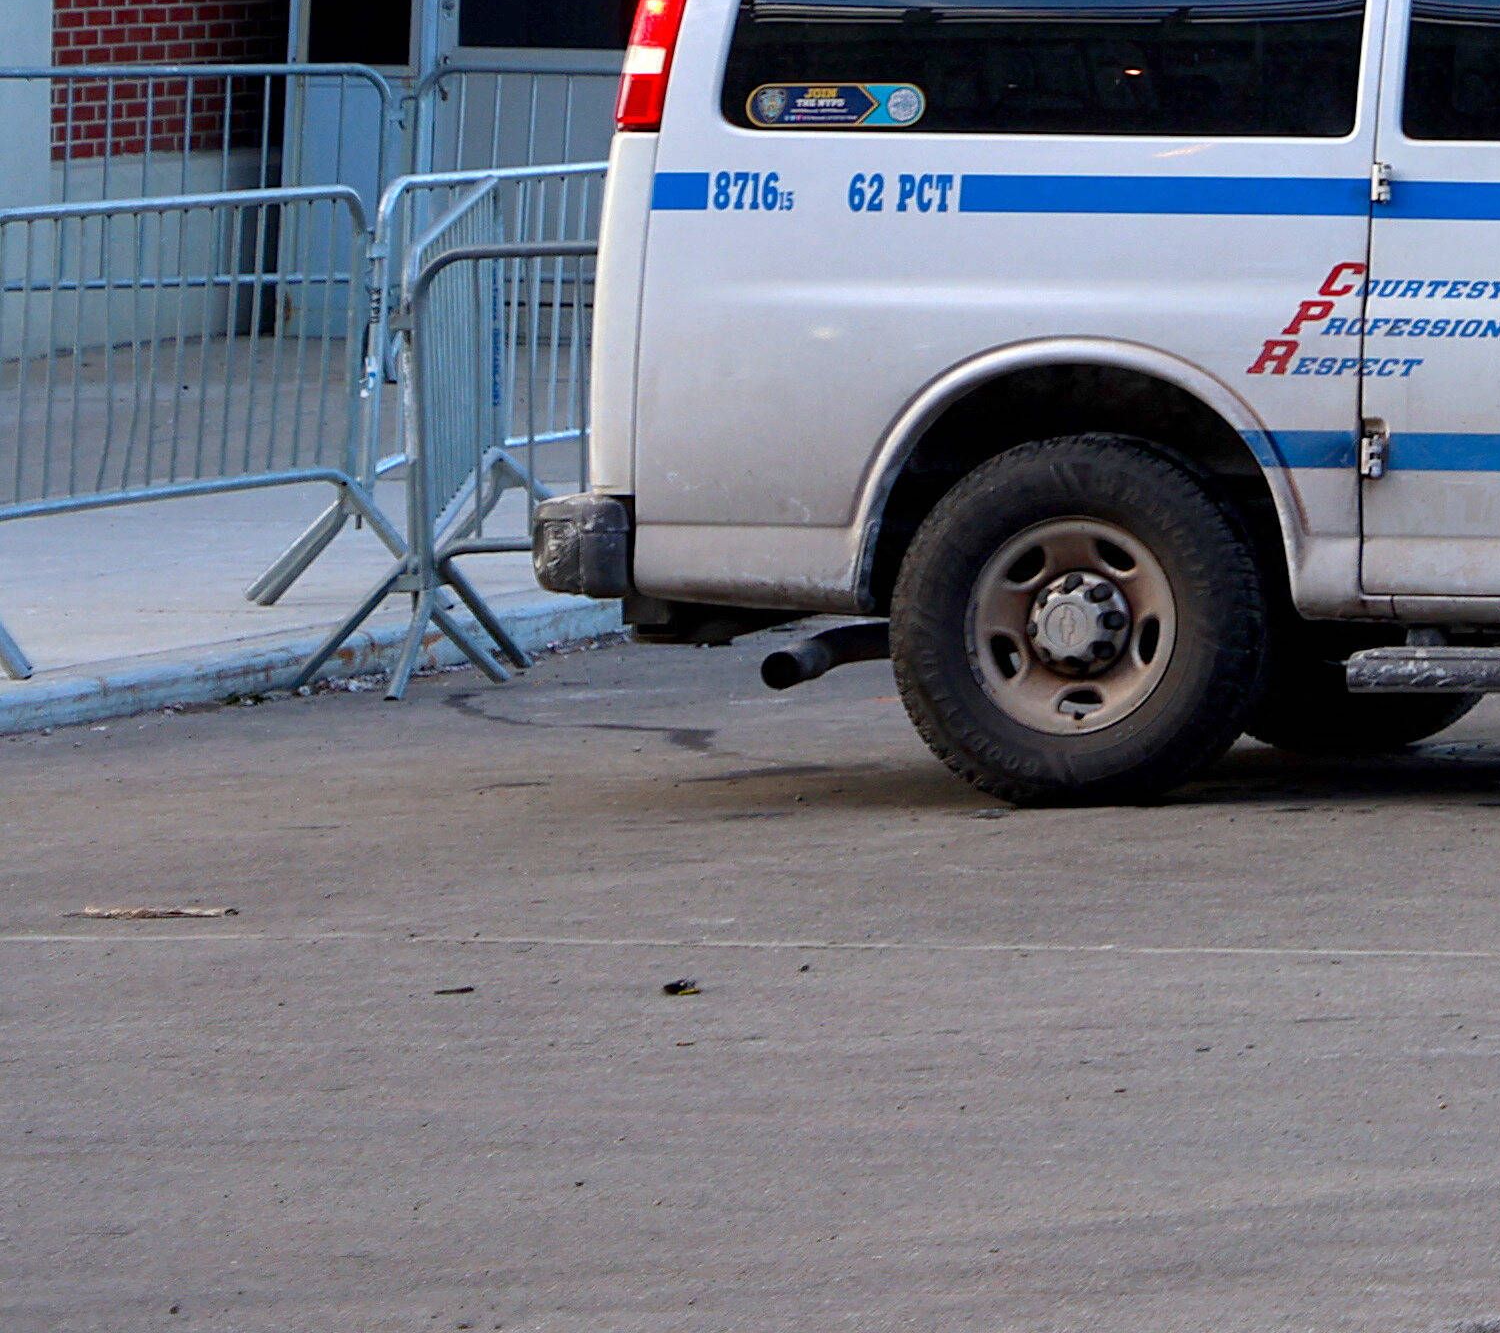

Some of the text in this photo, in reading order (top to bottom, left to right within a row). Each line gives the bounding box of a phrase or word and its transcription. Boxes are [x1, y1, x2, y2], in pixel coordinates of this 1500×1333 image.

[796, 98, 846, 108] THE NYPD
[804, 88, 838, 98] JOIN
[713, 171, 953, 212] 8716 15 62 PCT
[1246, 339, 1425, 377] RESPECT
